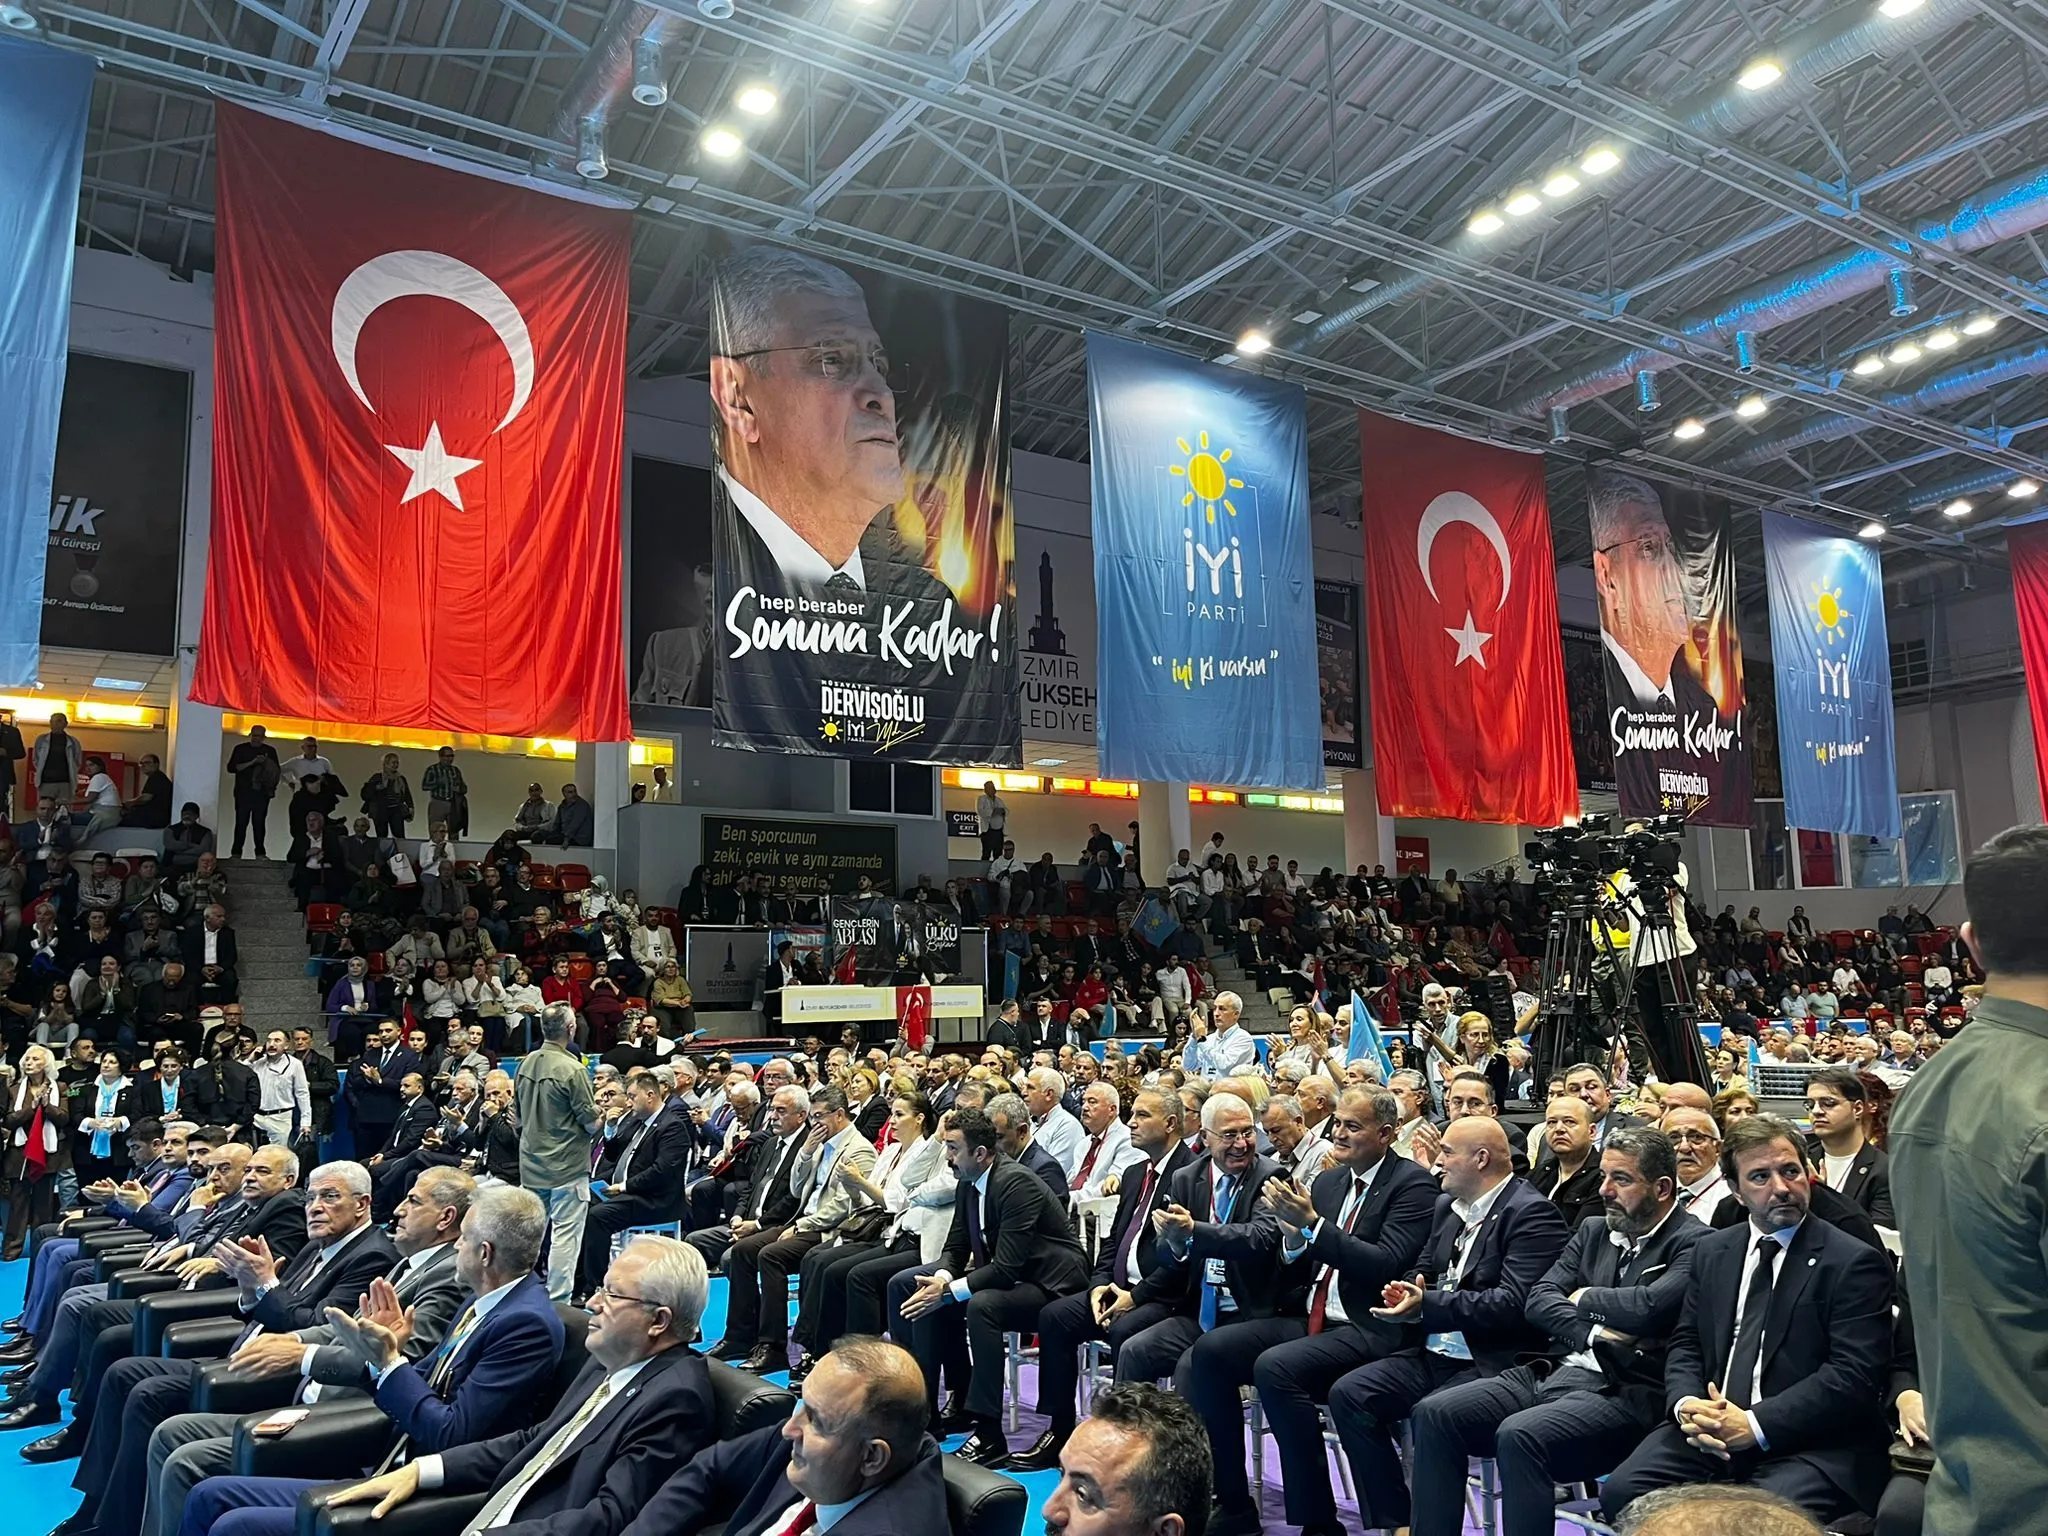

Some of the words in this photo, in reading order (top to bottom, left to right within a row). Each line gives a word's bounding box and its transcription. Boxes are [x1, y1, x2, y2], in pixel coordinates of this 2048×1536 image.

[62, 538, 101, 551] Güreşçi
[1183, 527, 1243, 599] İYİ
[759, 594, 795, 614] hep
[799, 596, 865, 616] beraber
[1187, 602, 1245, 624] PARTİ
[725, 585, 868, 659] Sonuna
[1816, 648, 1850, 699] İYİ
[821, 686, 925, 723] DERVİŞOĞLU
[847, 720, 865, 738] İYİ
[1627, 712, 1644, 725] hep
[1645, 712, 1676, 723] beraber
[1610, 705, 1680, 757] Sonuna
[721, 824, 746, 842] Ben
[750, 827, 817, 847] sporcunun
[713, 848, 742, 867] zeki,
[746, 849, 780, 868] çevik
[785, 852, 799, 865] ve
[803, 854, 828, 871] aynı
[831, 854, 883, 870] zamanda
[835, 928, 876, 946] ABLASI
[925, 922, 958, 941] ÜLKÜ
